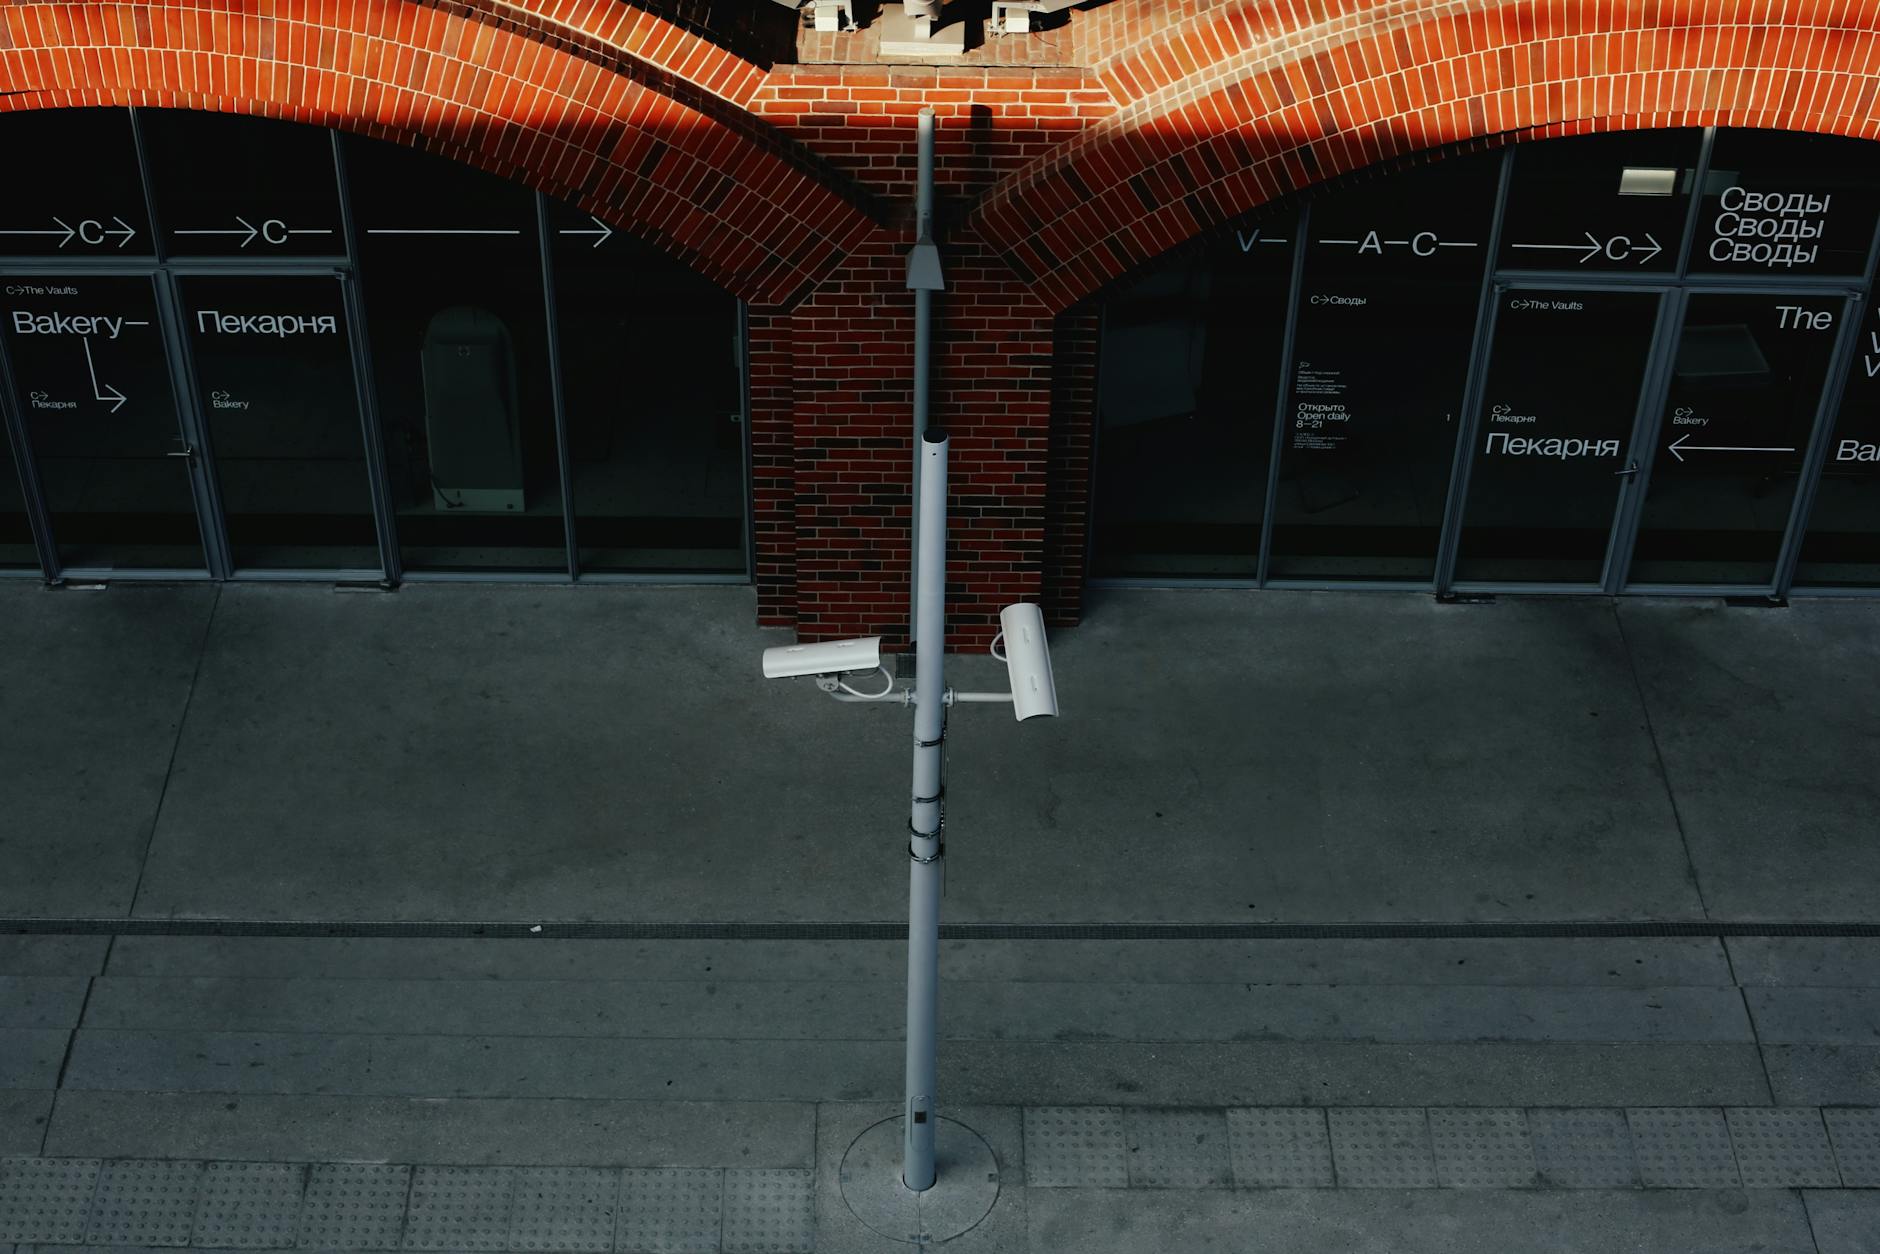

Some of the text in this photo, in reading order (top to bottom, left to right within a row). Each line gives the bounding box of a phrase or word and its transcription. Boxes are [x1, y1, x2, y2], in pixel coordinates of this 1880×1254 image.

[1720, 186, 1831, 218] Своды
[1714, 212, 1825, 243] Своды
[1709, 237, 1819, 268] Своды
[46, 286, 78, 296] Vaults
[1551, 301, 1583, 311] Vaults
[1774, 306, 1833, 330] The
[12, 311, 123, 339] Bakery
[197, 310, 337, 338] Пекарня
[31, 400, 77, 410] Пекарня
[212, 400, 250, 410] Bakery
[1298, 402, 1345, 413] Открыто
[1297, 412, 1351, 422] Open daily
[1490, 414, 1536, 424] Пекарня
[1672, 416, 1710, 426] Bakery
[1485, 432, 1620, 460] Пекарня
